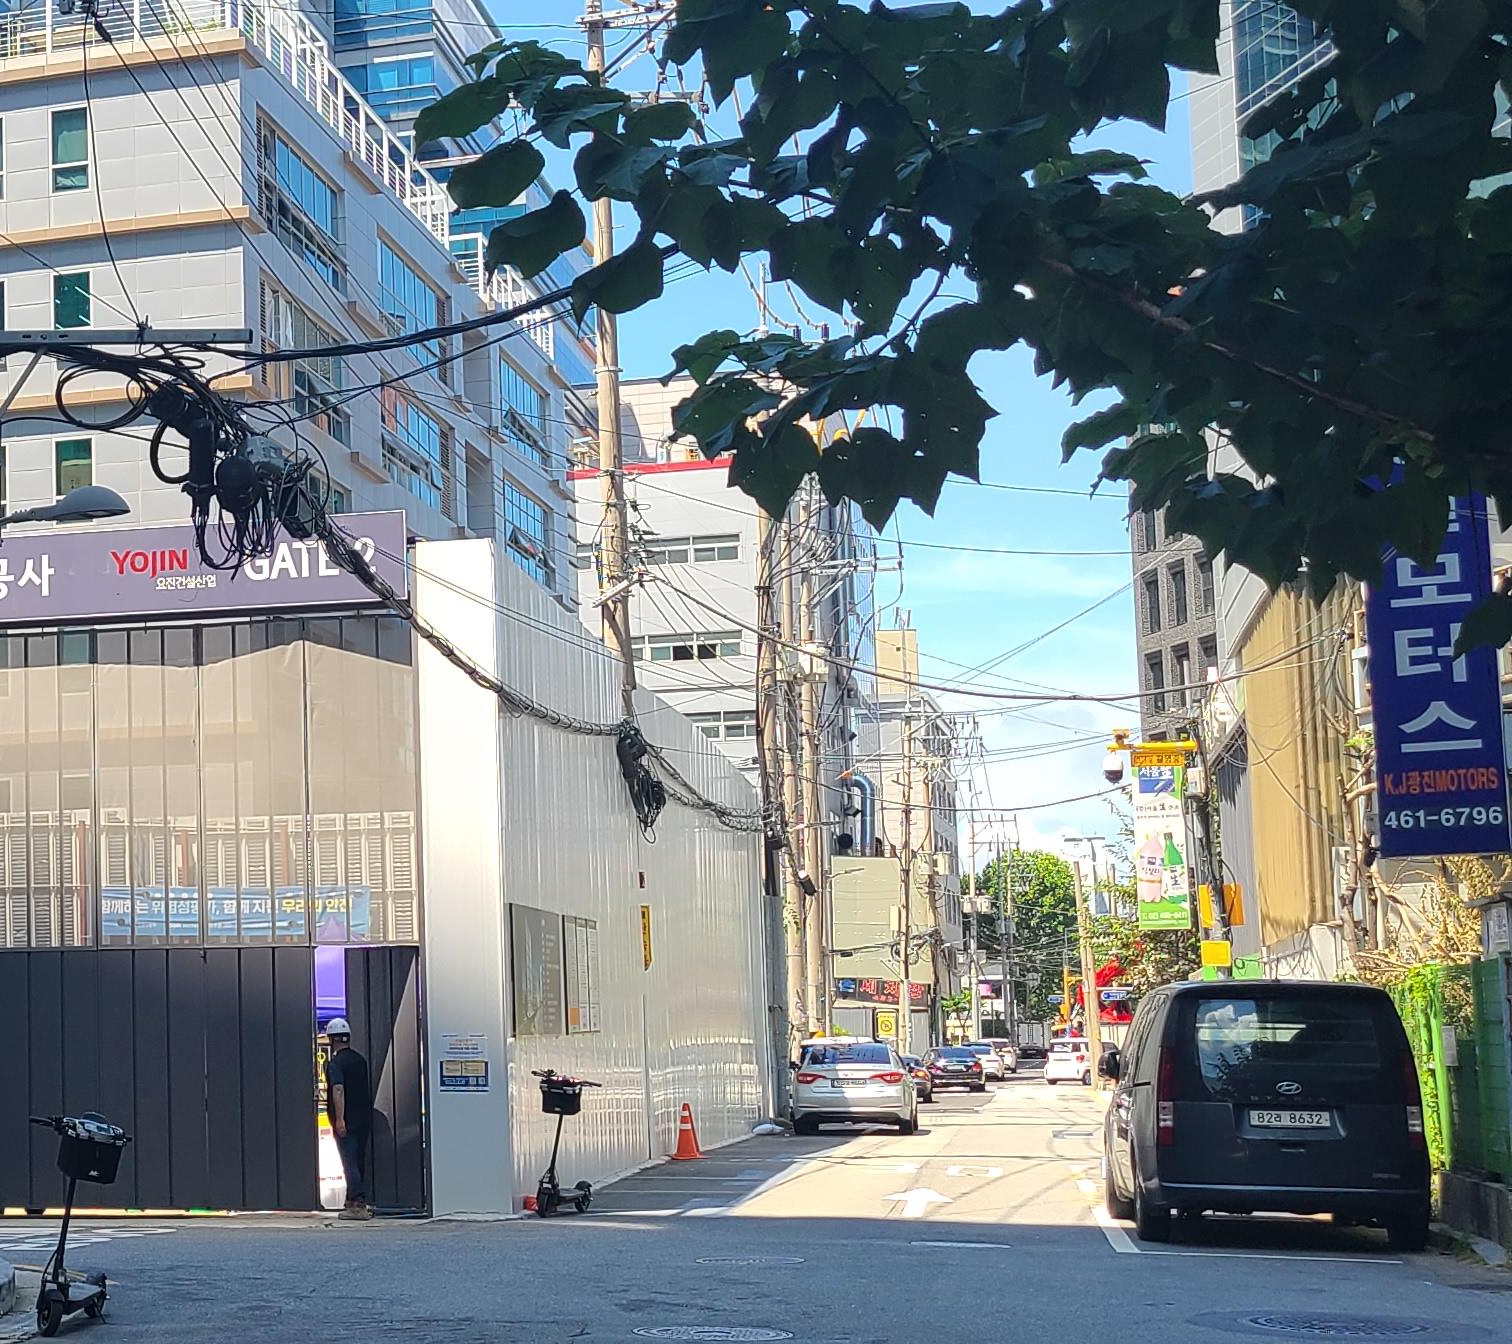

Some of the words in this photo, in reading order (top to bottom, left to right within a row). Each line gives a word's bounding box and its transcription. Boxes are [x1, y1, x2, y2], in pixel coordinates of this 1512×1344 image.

[110, 548, 189, 579] YOJIN
[243, 539, 340, 581] GATE
[155, 575, 217, 591] 요진건설산업
[1384, 767, 1499, 795] K.J광진MOTORS
[1384, 806, 1503, 829] 461-6796
[1289, 1112, 1323, 1125] 8632
